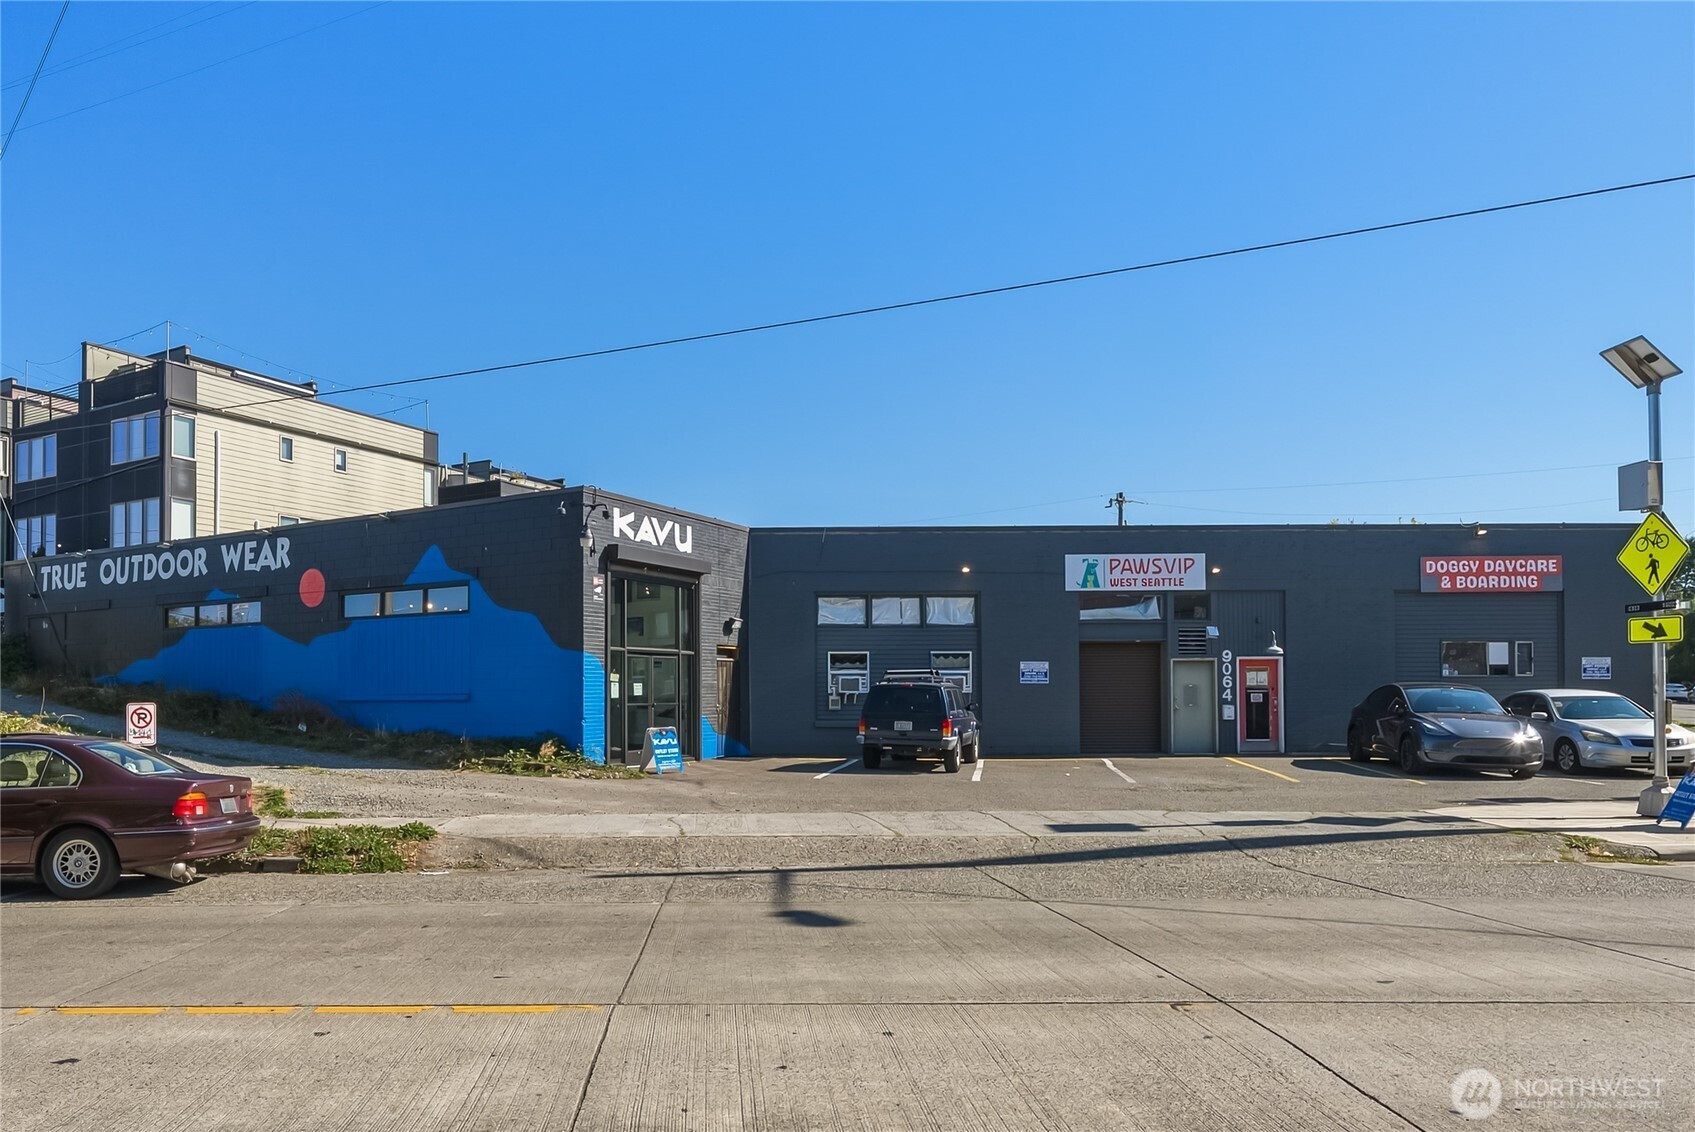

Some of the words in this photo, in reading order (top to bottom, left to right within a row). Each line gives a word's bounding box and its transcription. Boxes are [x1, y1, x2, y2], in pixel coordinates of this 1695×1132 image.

[613, 507, 692, 553] KAVU
[41, 561, 87, 592] TRUE
[100, 547, 208, 585] OUTDOOR
[221, 536, 291, 574] WEAR
[1109, 558, 1196, 575] PAWSVIP
[1425, 560, 1480, 574] DOGGY
[1484, 559, 1558, 573] DAYCARE
[1109, 577, 1139, 588] WEST
[1141, 577, 1185, 587] SEATTLE
[1441, 575, 1451, 589] &
[1456, 575, 1538, 588] BOARDING
[1221, 649, 1233, 702] 9064
